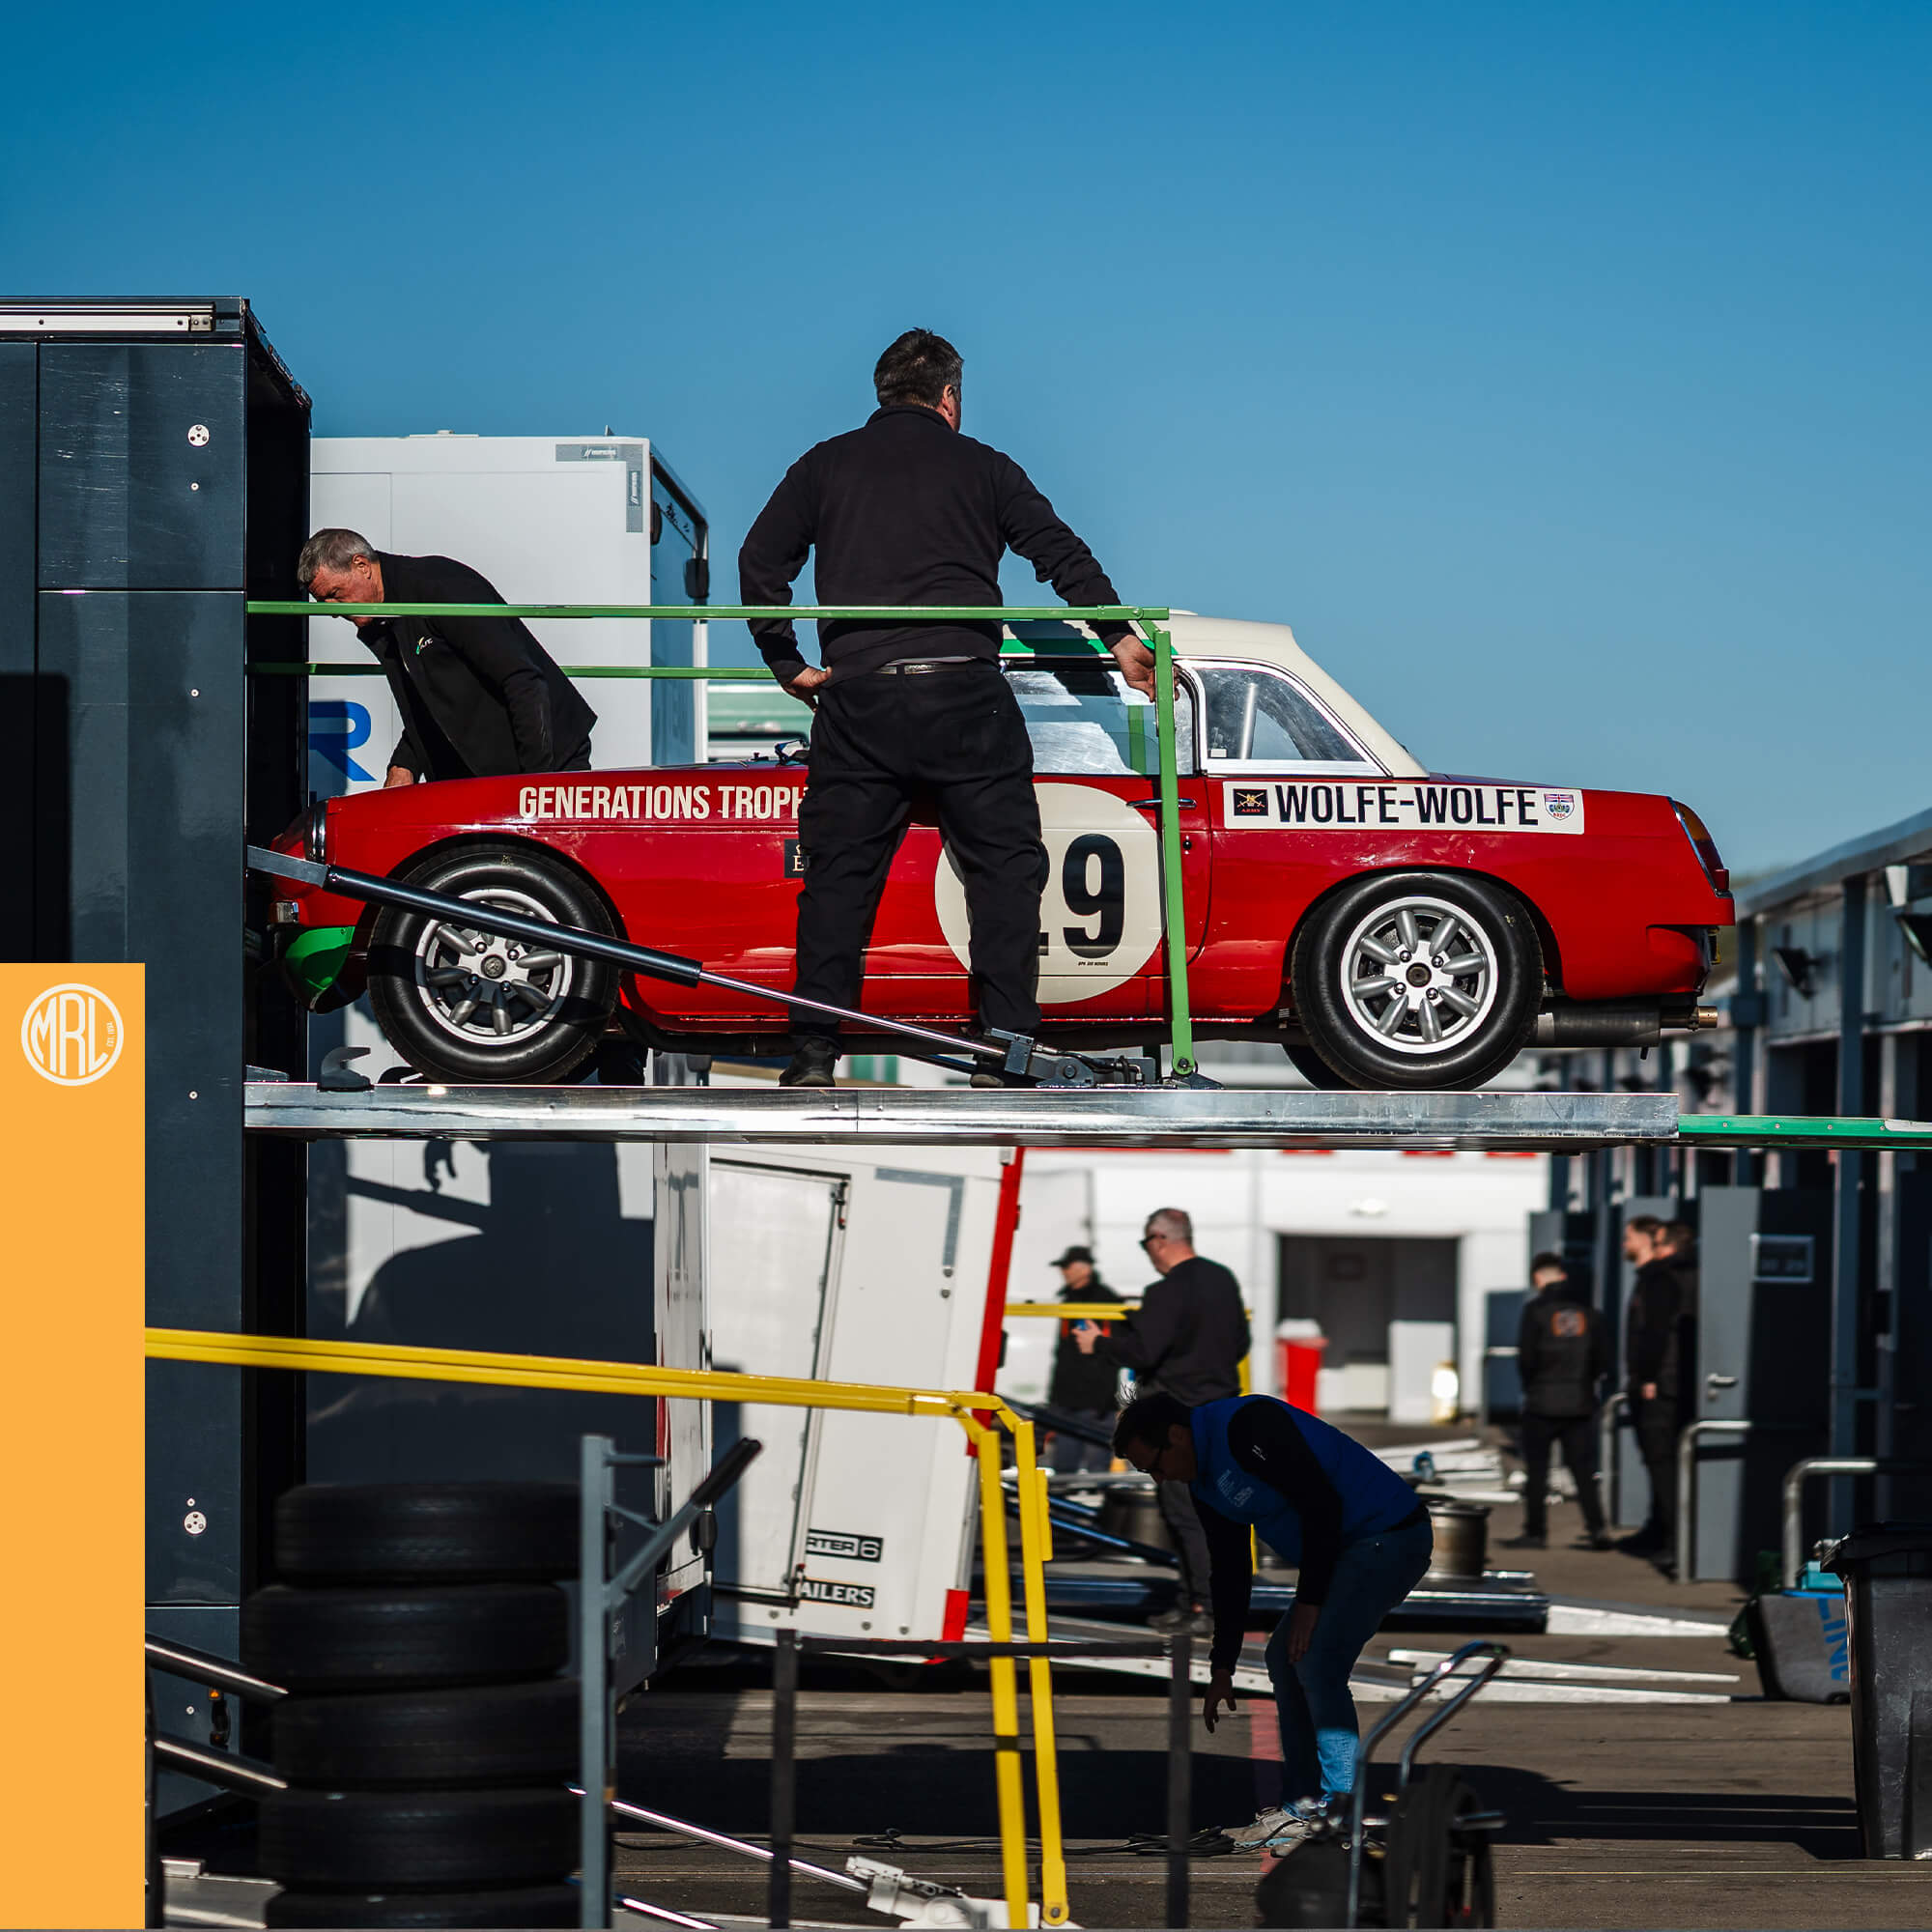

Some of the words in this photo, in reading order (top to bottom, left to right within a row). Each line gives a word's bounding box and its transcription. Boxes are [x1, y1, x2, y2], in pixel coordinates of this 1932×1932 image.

[519, 786, 710, 819] GENERATIONS
[1275, 784, 1539, 825] WOLFE-WOLFE
[1037, 833, 1125, 959] 9
[861, 1541, 880, 1559] 6
